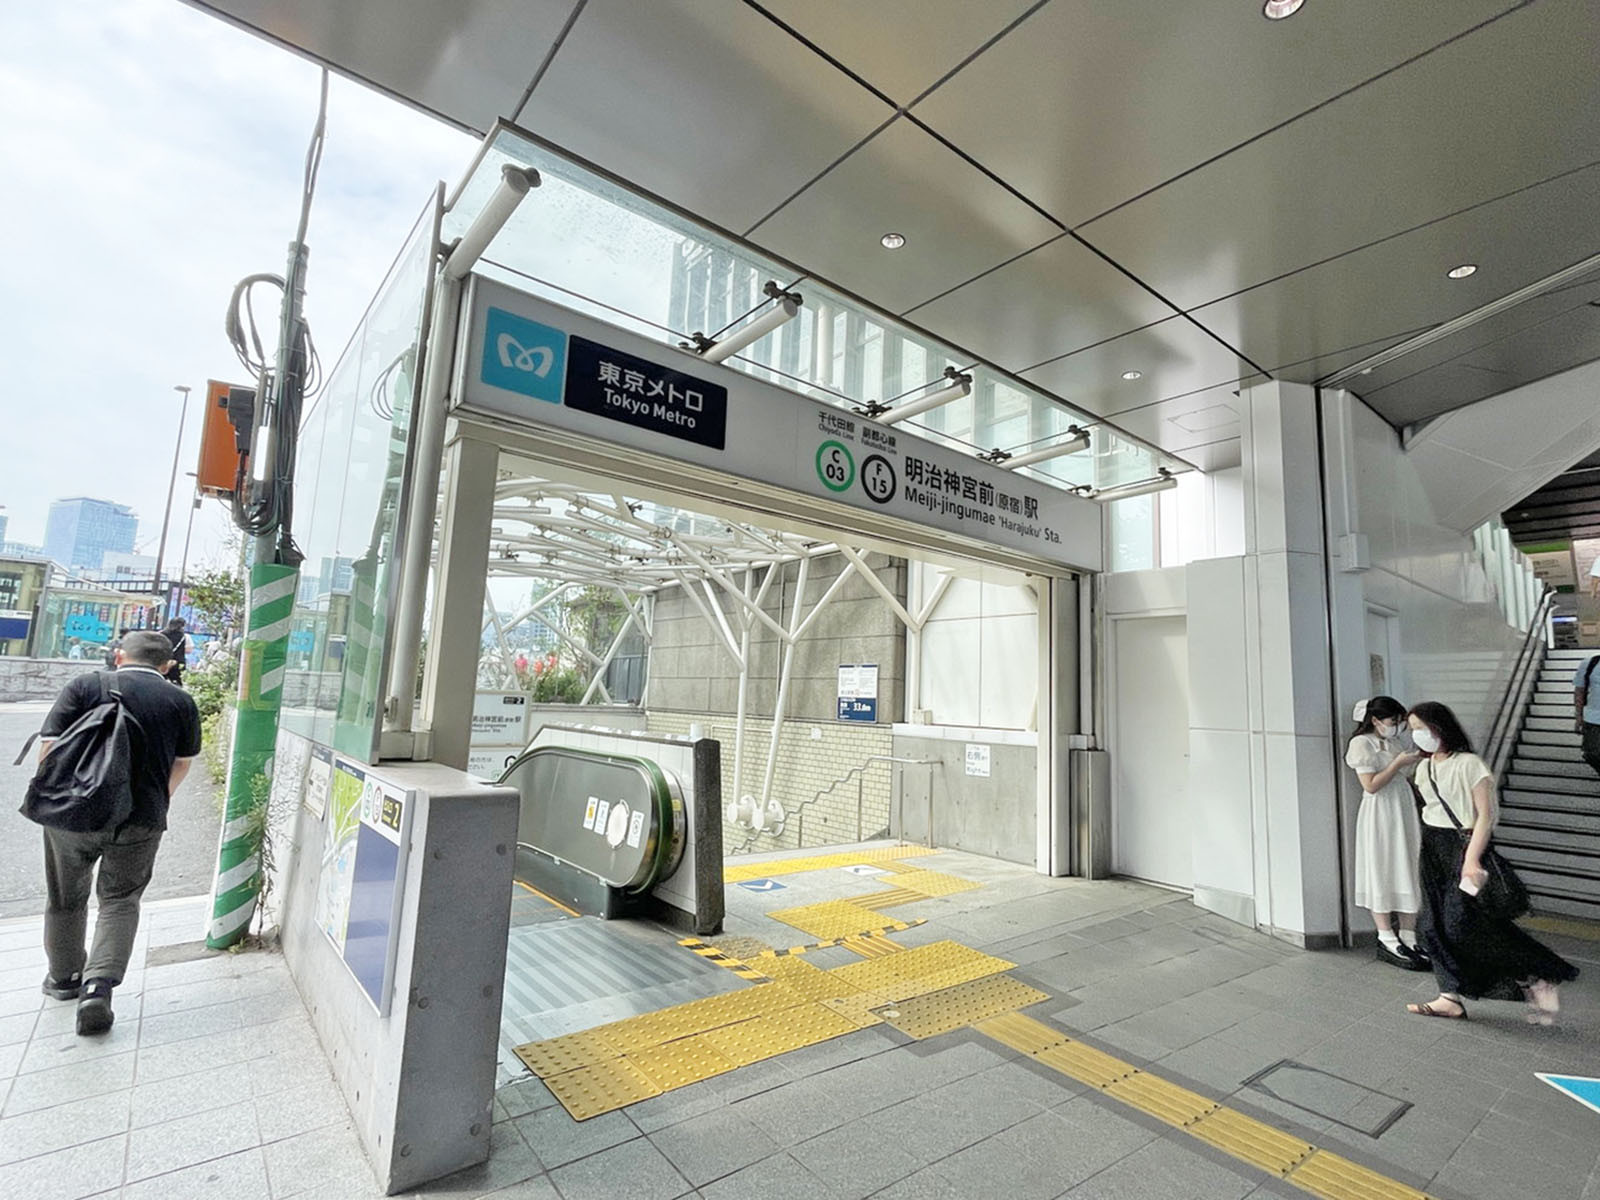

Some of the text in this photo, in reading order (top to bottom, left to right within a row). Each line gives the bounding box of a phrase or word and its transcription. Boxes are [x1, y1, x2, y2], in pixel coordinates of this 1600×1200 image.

[598, 360, 704, 412] 東京メトロ
[603, 387, 697, 429] Tokyo Metro
[818, 410, 856, 433] 千代田線
[831, 449, 841, 464] C
[825, 463, 846, 482] 03
[875, 462, 883, 476] F
[871, 476, 888, 494] 15
[904, 485, 996, 525] Meiji-jingumae
[1044, 526, 1063, 545] Sta.
